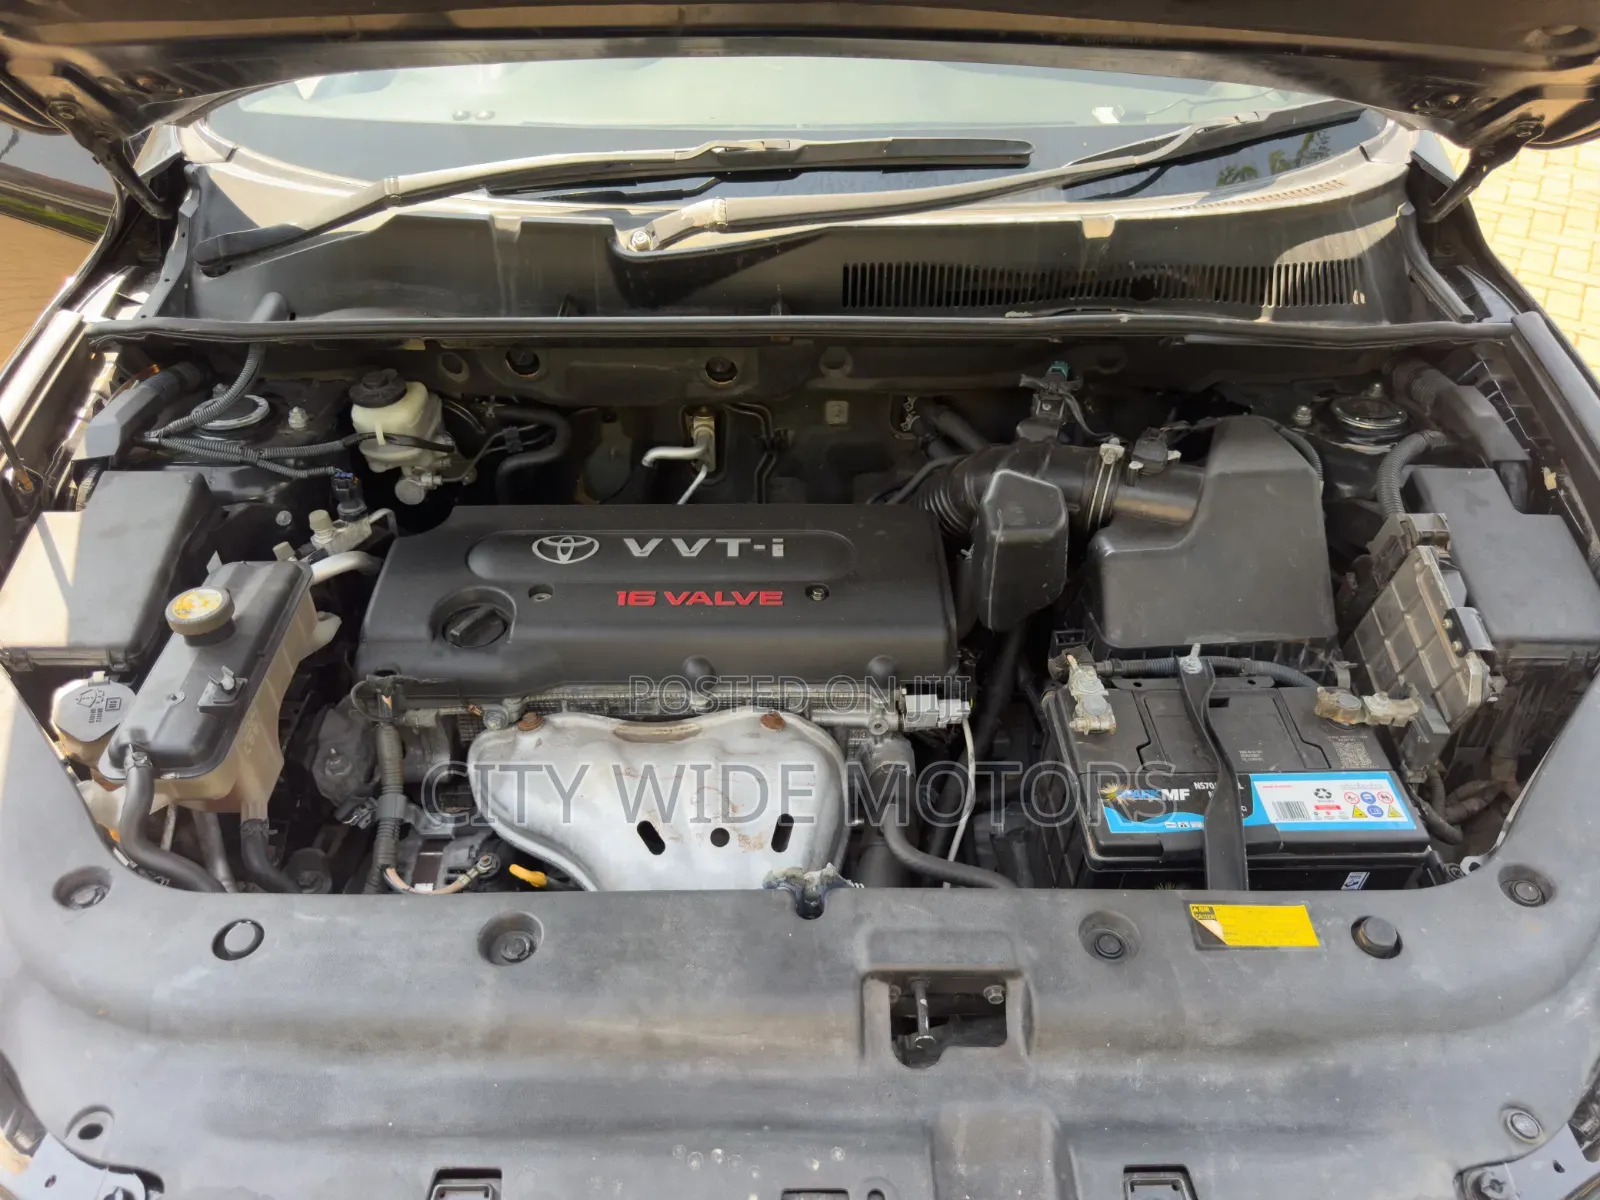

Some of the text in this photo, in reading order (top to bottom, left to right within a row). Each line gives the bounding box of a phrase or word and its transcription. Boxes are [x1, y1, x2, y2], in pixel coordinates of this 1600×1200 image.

[623, 537, 785, 558] VVT-i
[616, 590, 784, 607] 16 VALVE
